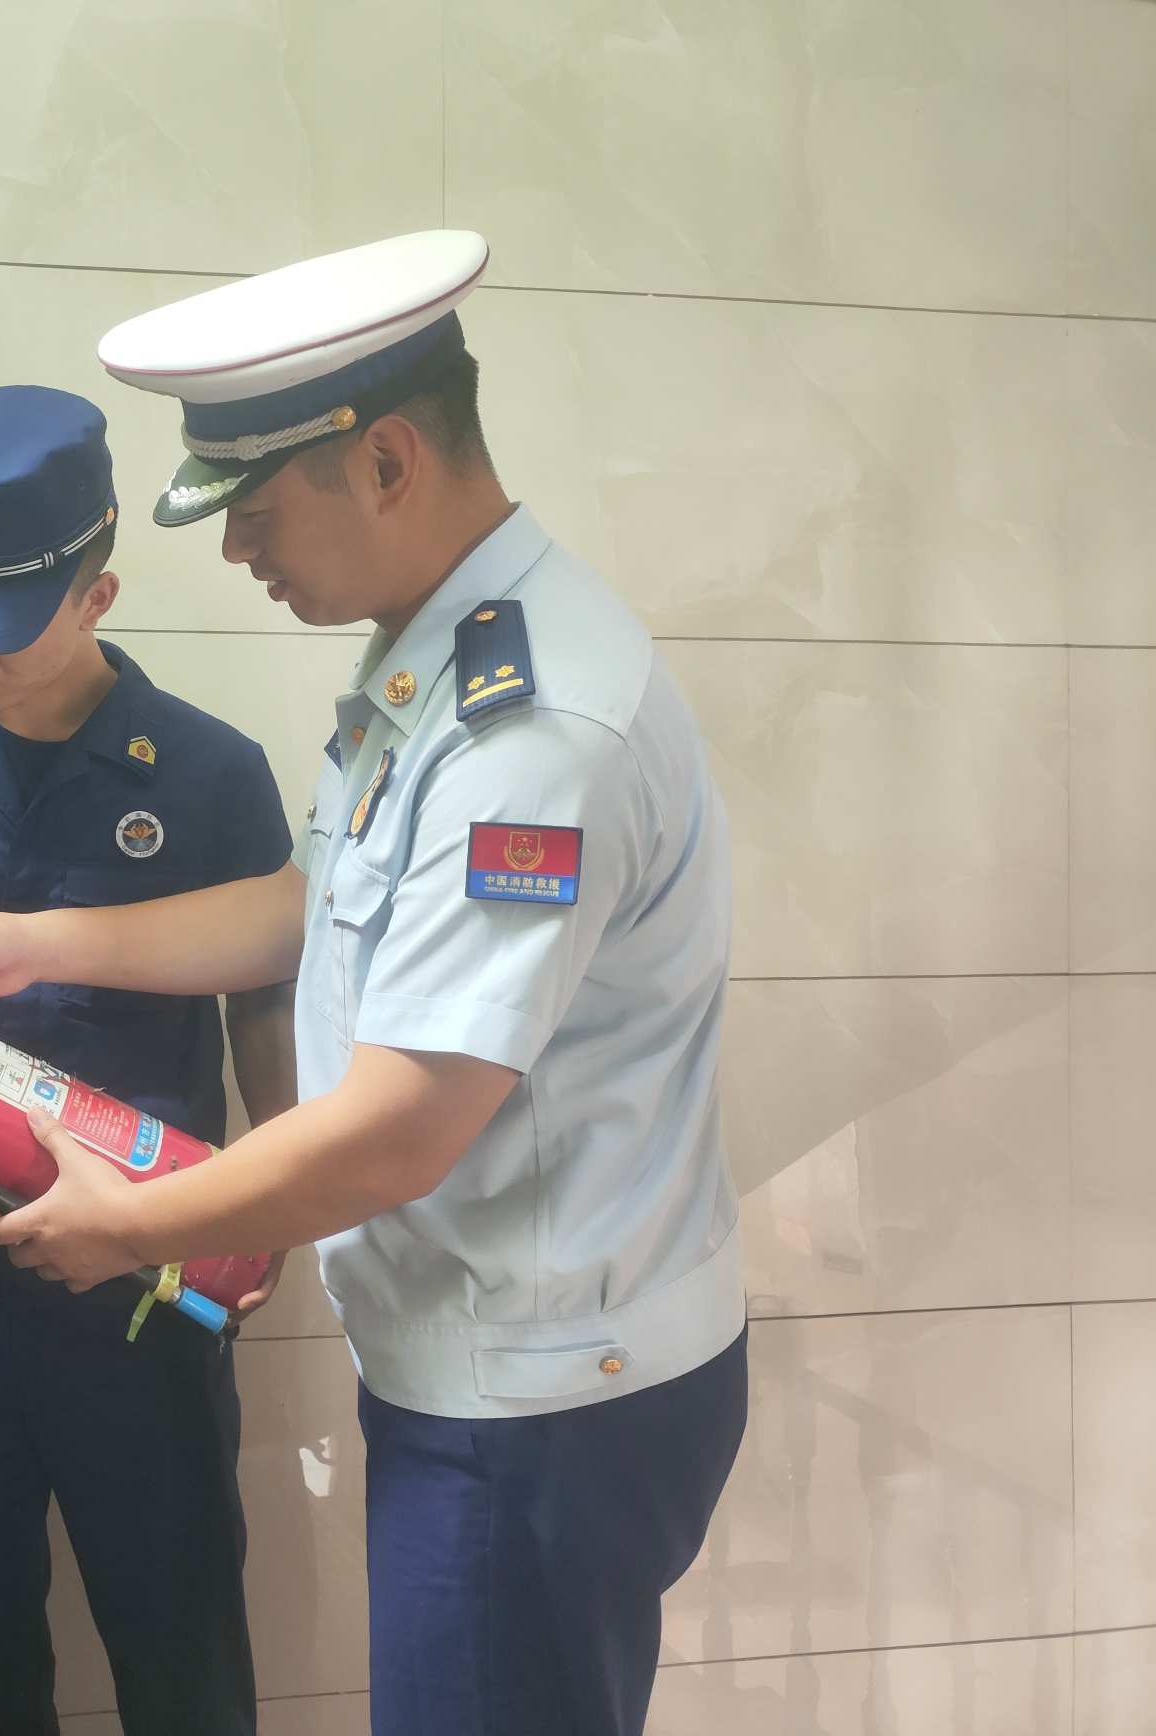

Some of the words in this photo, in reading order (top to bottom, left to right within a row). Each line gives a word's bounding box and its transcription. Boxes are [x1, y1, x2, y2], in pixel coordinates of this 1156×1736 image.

[484, 874, 560, 890] 中国消防救援
